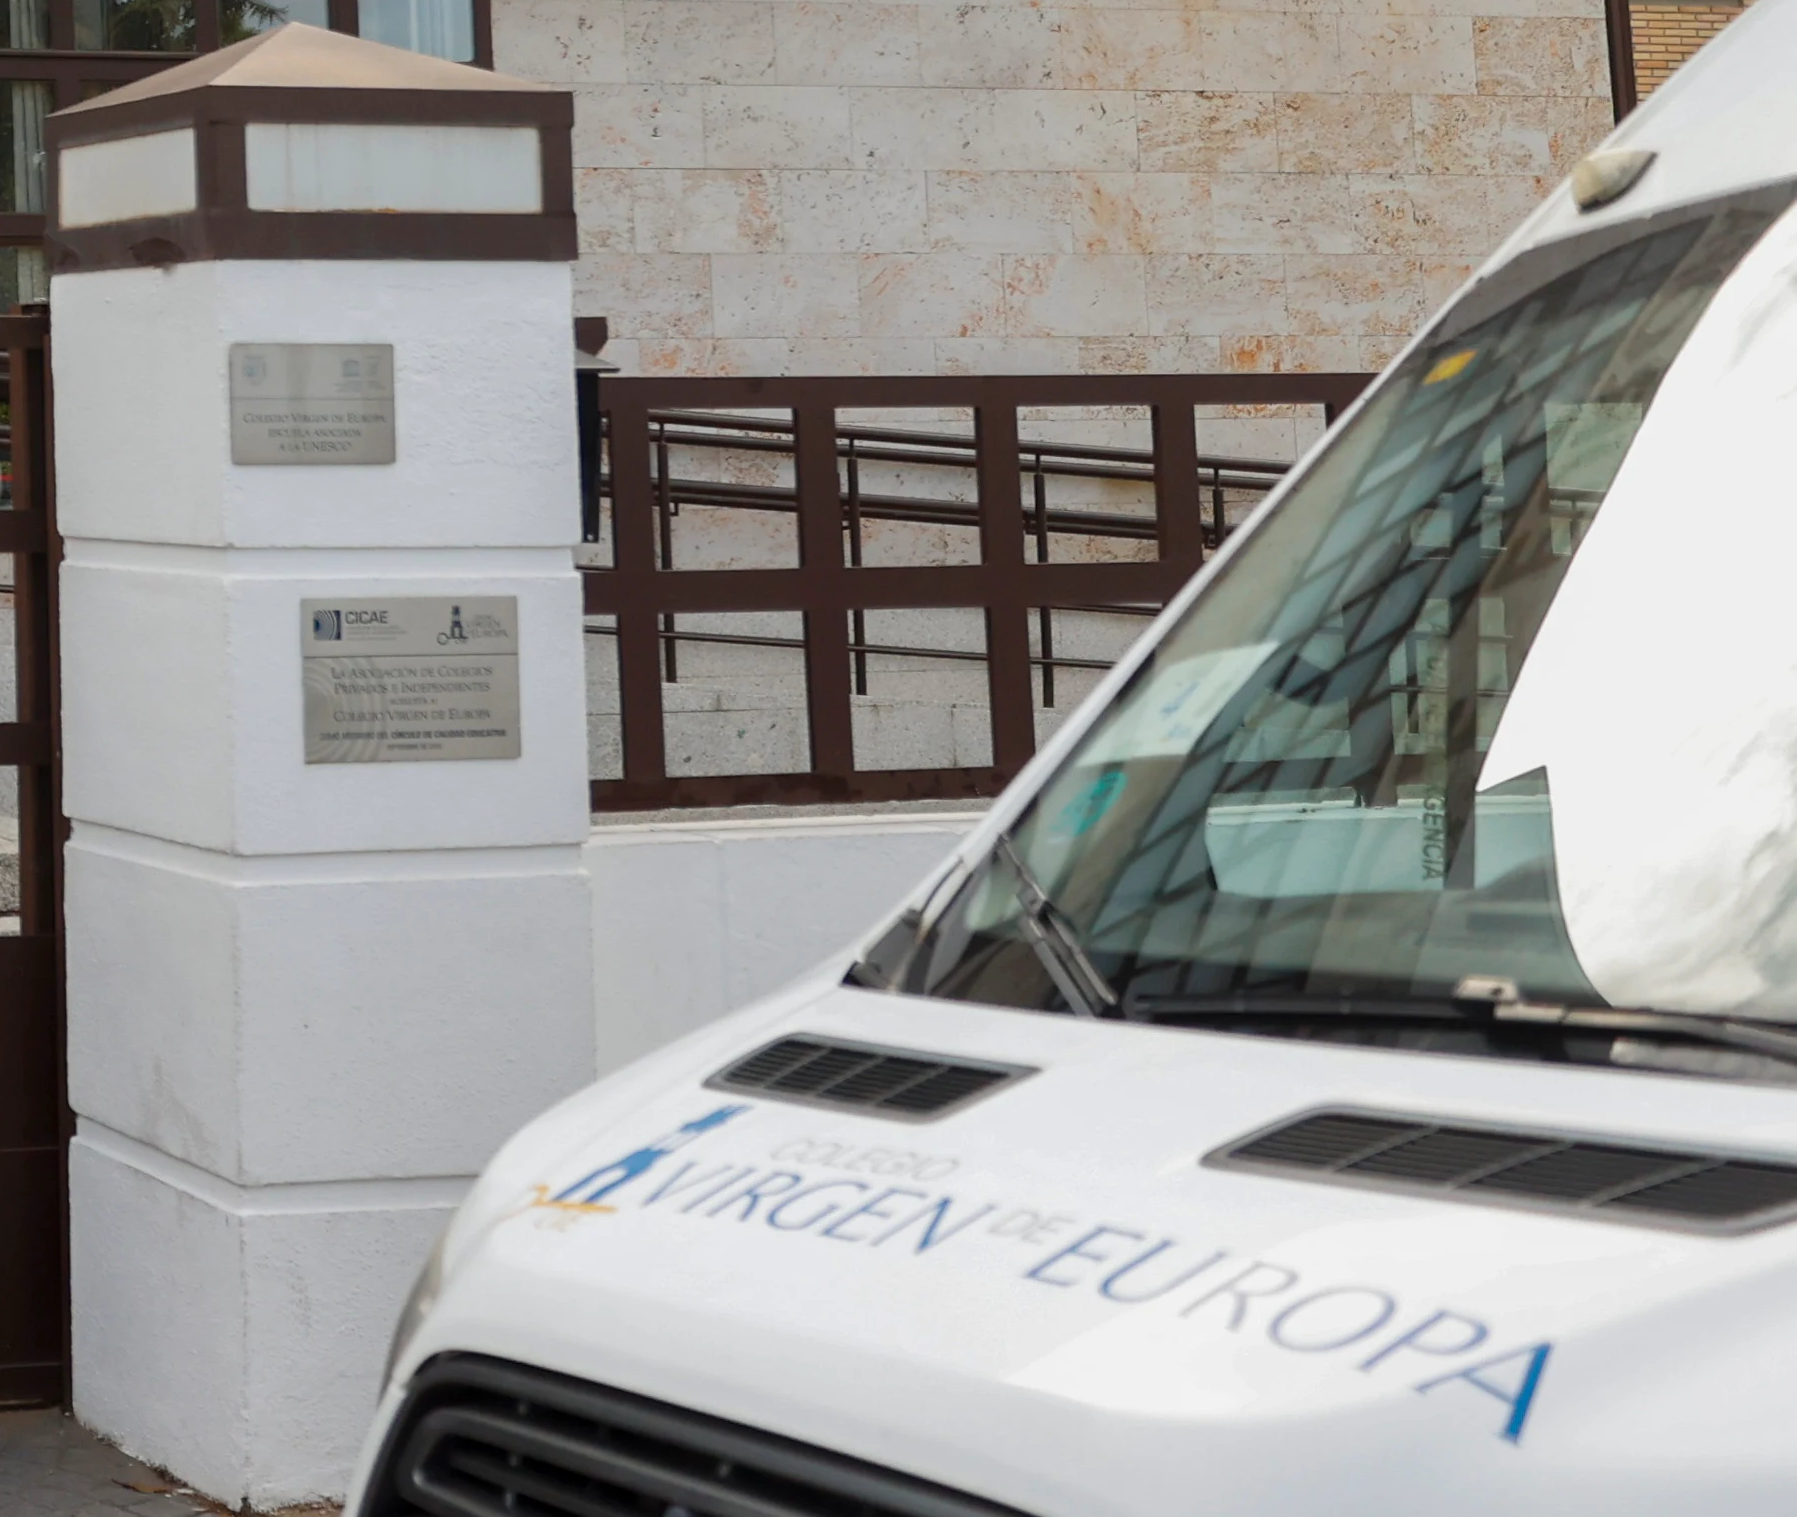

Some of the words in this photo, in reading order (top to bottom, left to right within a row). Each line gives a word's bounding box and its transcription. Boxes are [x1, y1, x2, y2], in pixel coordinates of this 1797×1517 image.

[345, 610, 389, 625] CICAE
[769, 1137, 962, 1182] COLEGIO
[639, 1160, 998, 1256] VIRGEN
[988, 1209, 1079, 1247] DE
[1021, 1224, 1556, 1449] EUROPA
